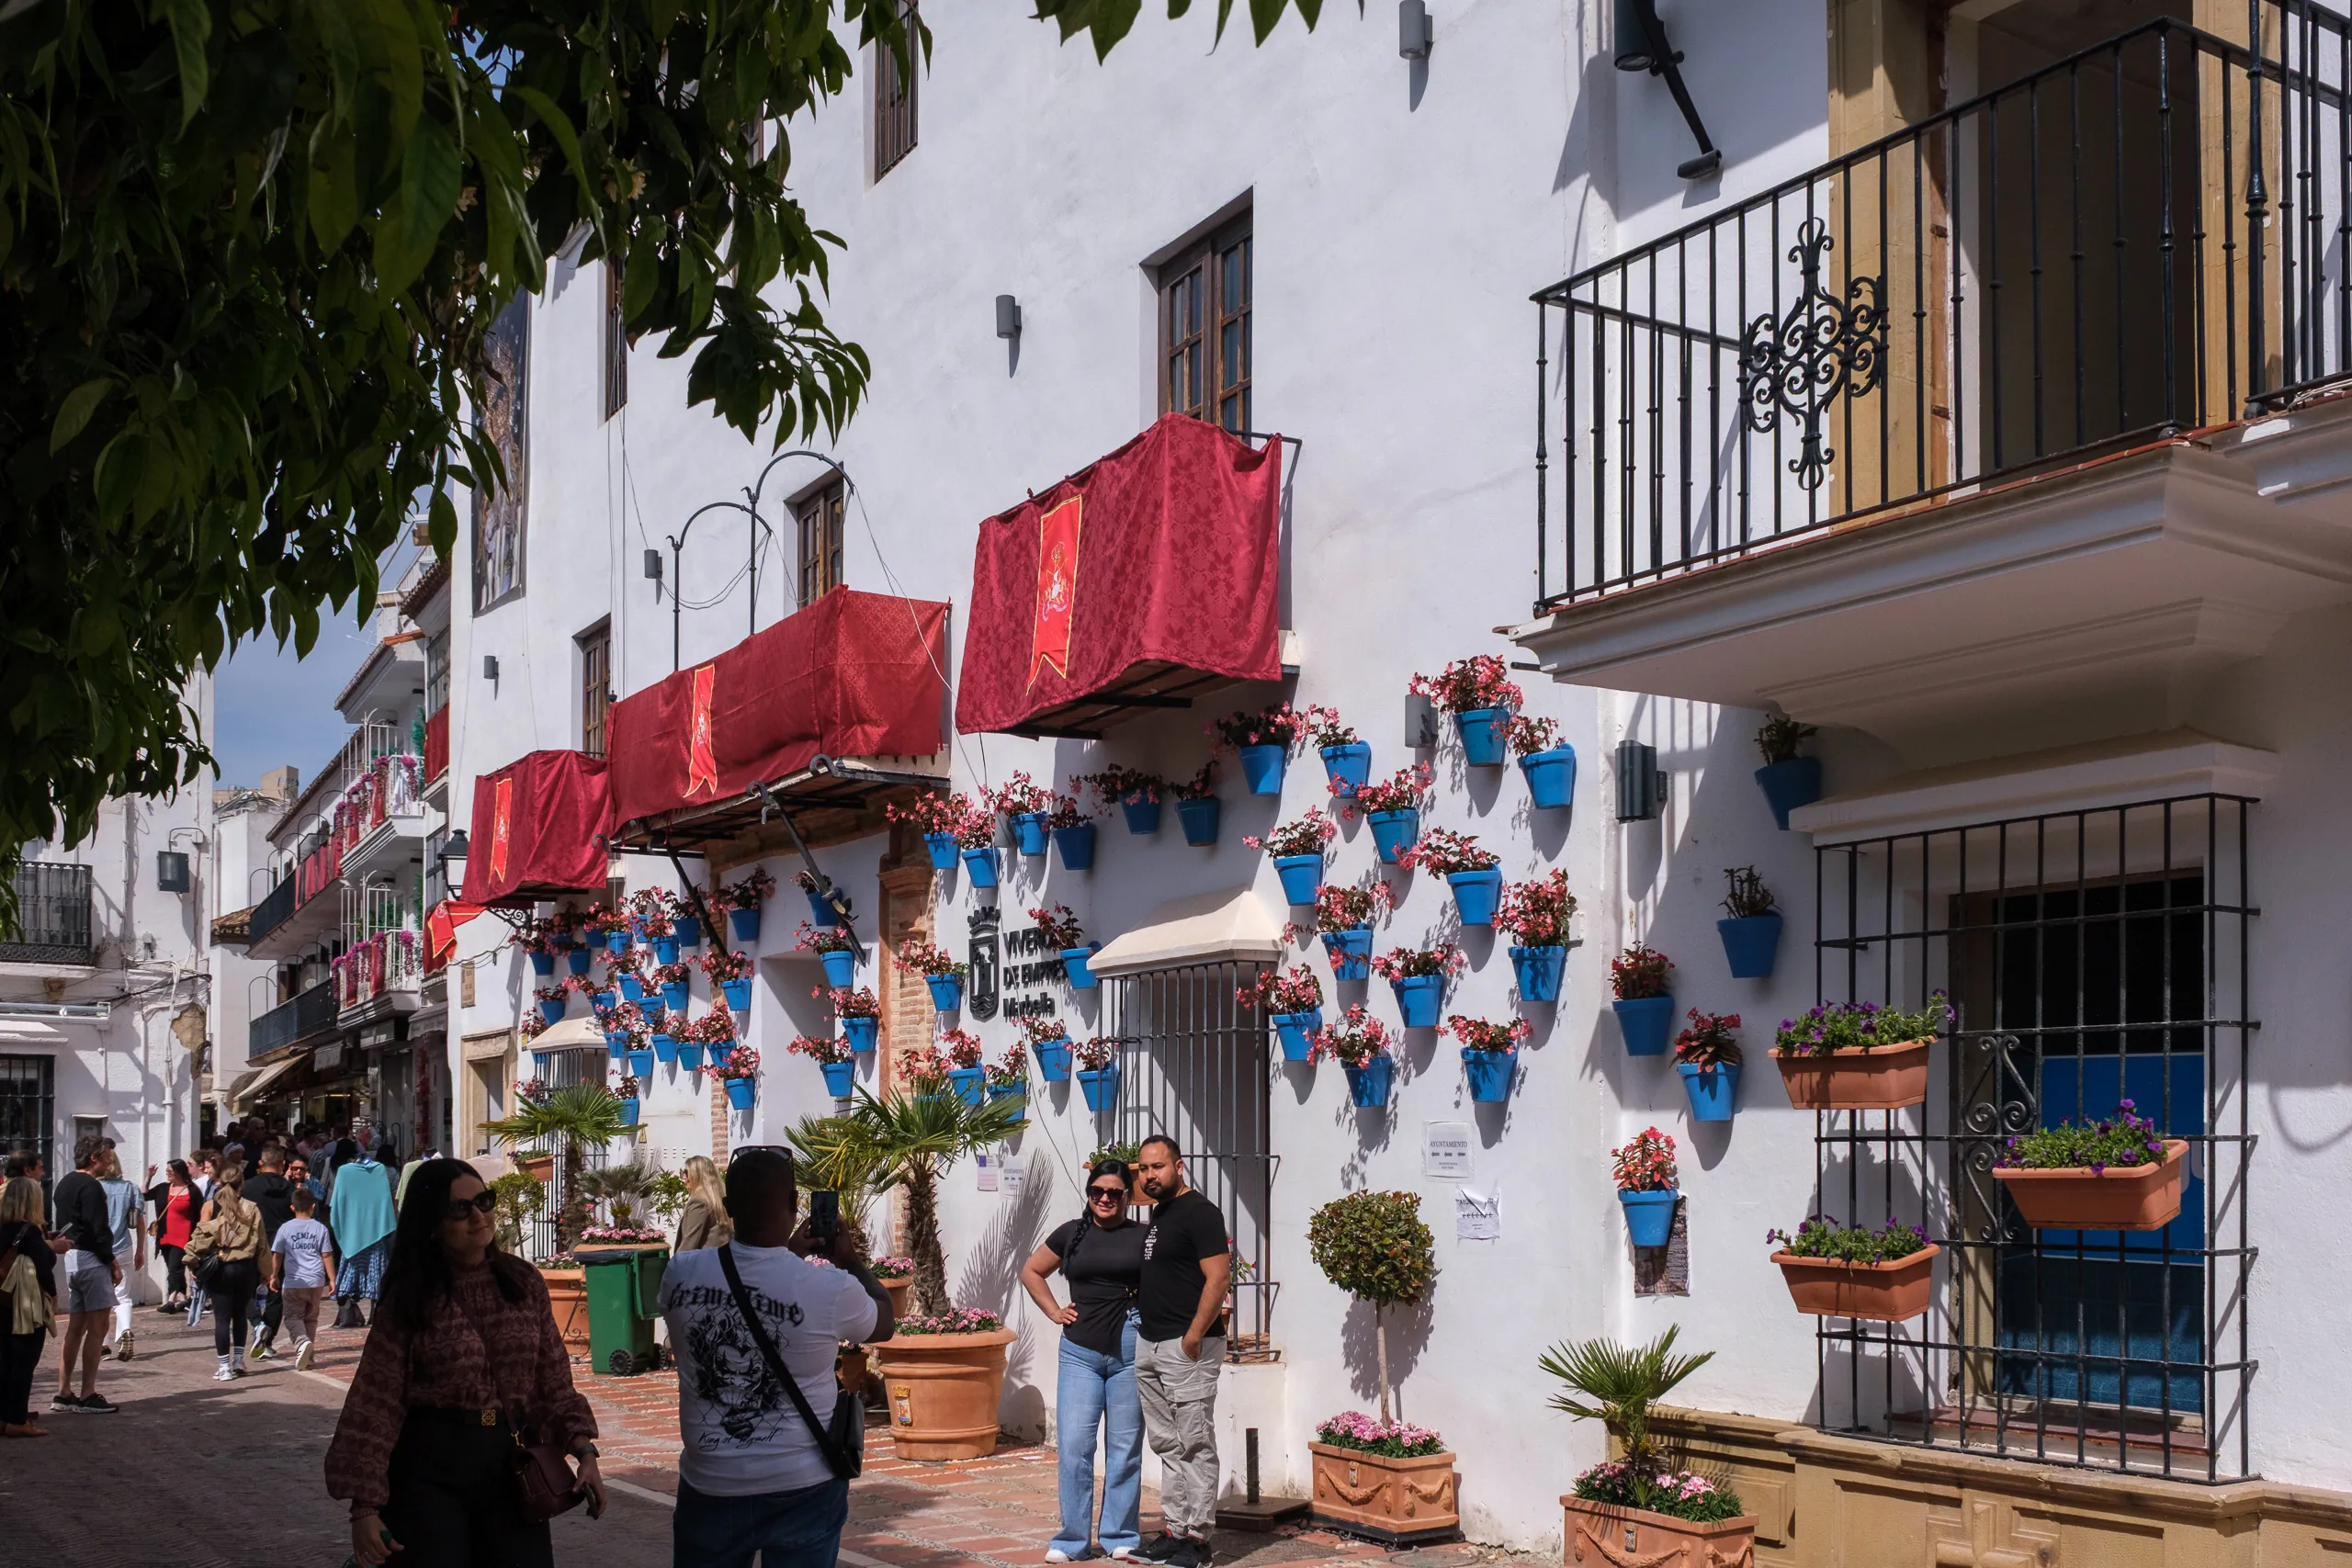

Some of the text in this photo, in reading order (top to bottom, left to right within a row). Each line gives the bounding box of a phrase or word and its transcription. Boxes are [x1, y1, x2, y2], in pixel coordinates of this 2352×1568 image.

[1003, 965, 1020, 990] DE
[1003, 992, 1056, 1021] Marbella
[291, 1242, 316, 1250] LONDON
[698, 1432, 722, 1451] King
